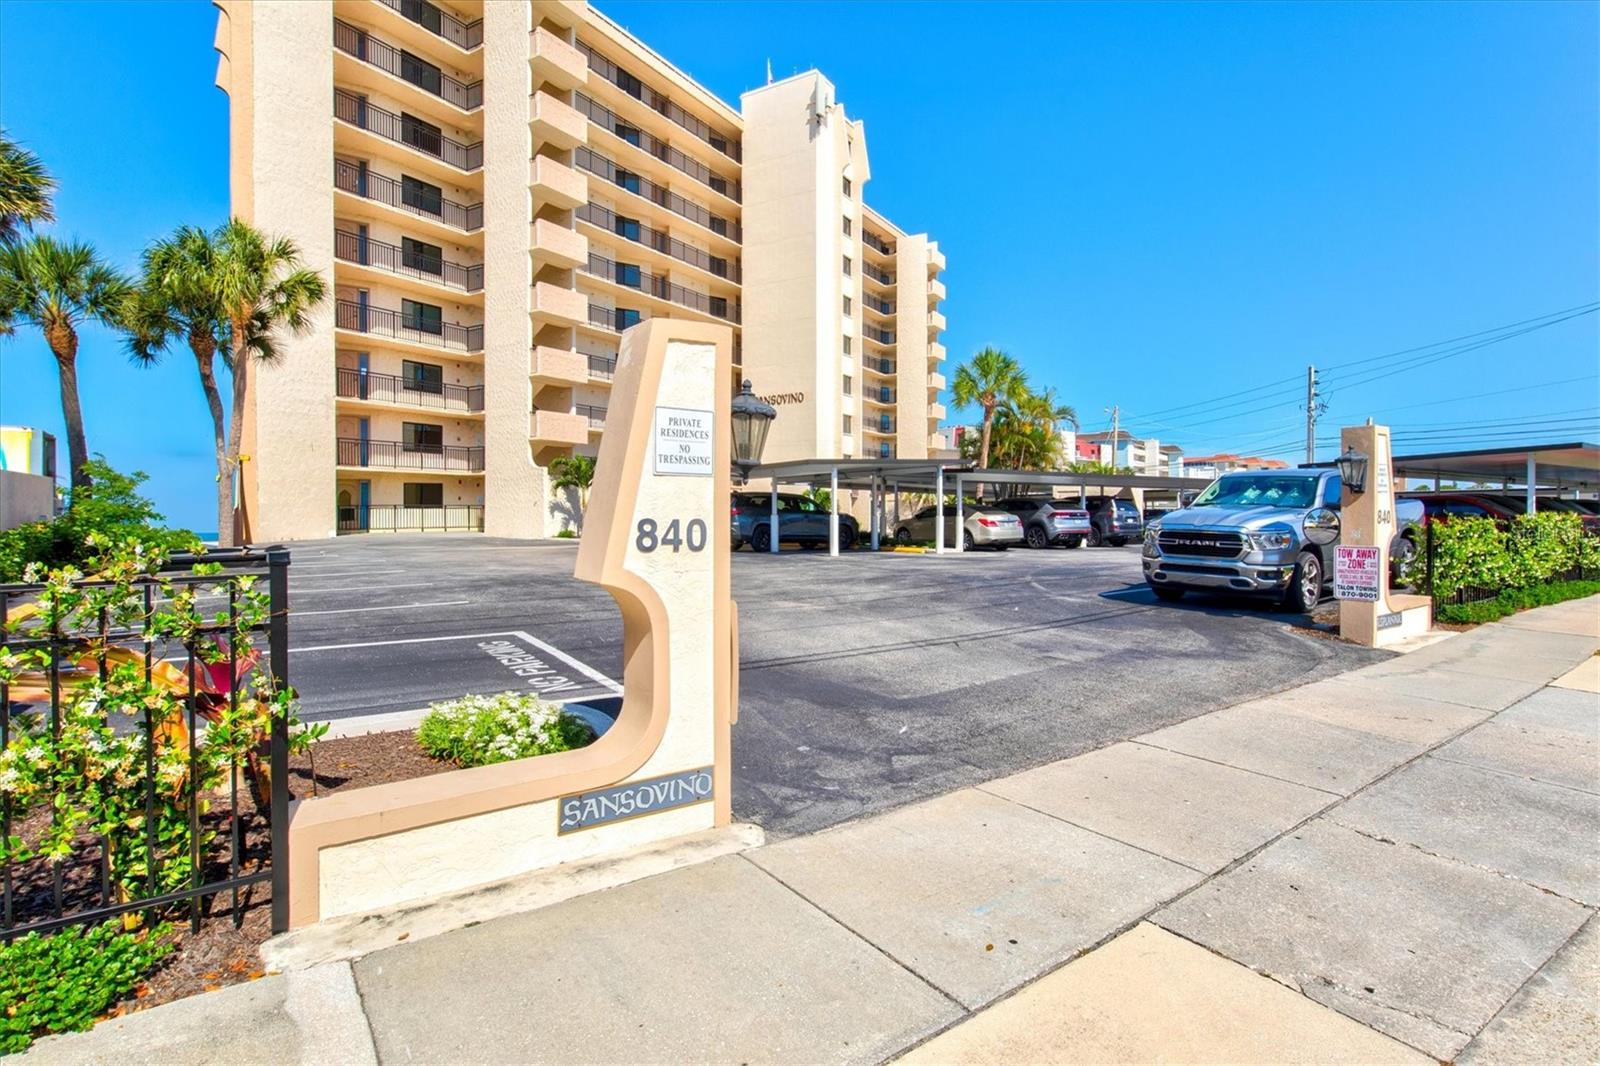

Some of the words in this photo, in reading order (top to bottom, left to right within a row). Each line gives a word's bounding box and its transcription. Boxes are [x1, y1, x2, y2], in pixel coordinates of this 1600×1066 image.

[759, 391, 804, 406] ANSOVINO
[668, 417, 702, 429] PRIVATE
[660, 428, 709, 440] RESIDENCES
[679, 444, 691, 454] NO
[658, 454, 711, 466] TRESPASSING
[1377, 509, 1390, 524] 840
[635, 517, 707, 554] 840
[1337, 548, 1353, 559] TOW
[1356, 549, 1377, 560] AWAY
[1347, 559, 1366, 569] ZONE
[1341, 590, 1377, 599] 870-9001
[477, 640, 558, 677] PARKING
[527, 675, 583, 693] NO
[560, 772, 713, 827] SANSOVINO
